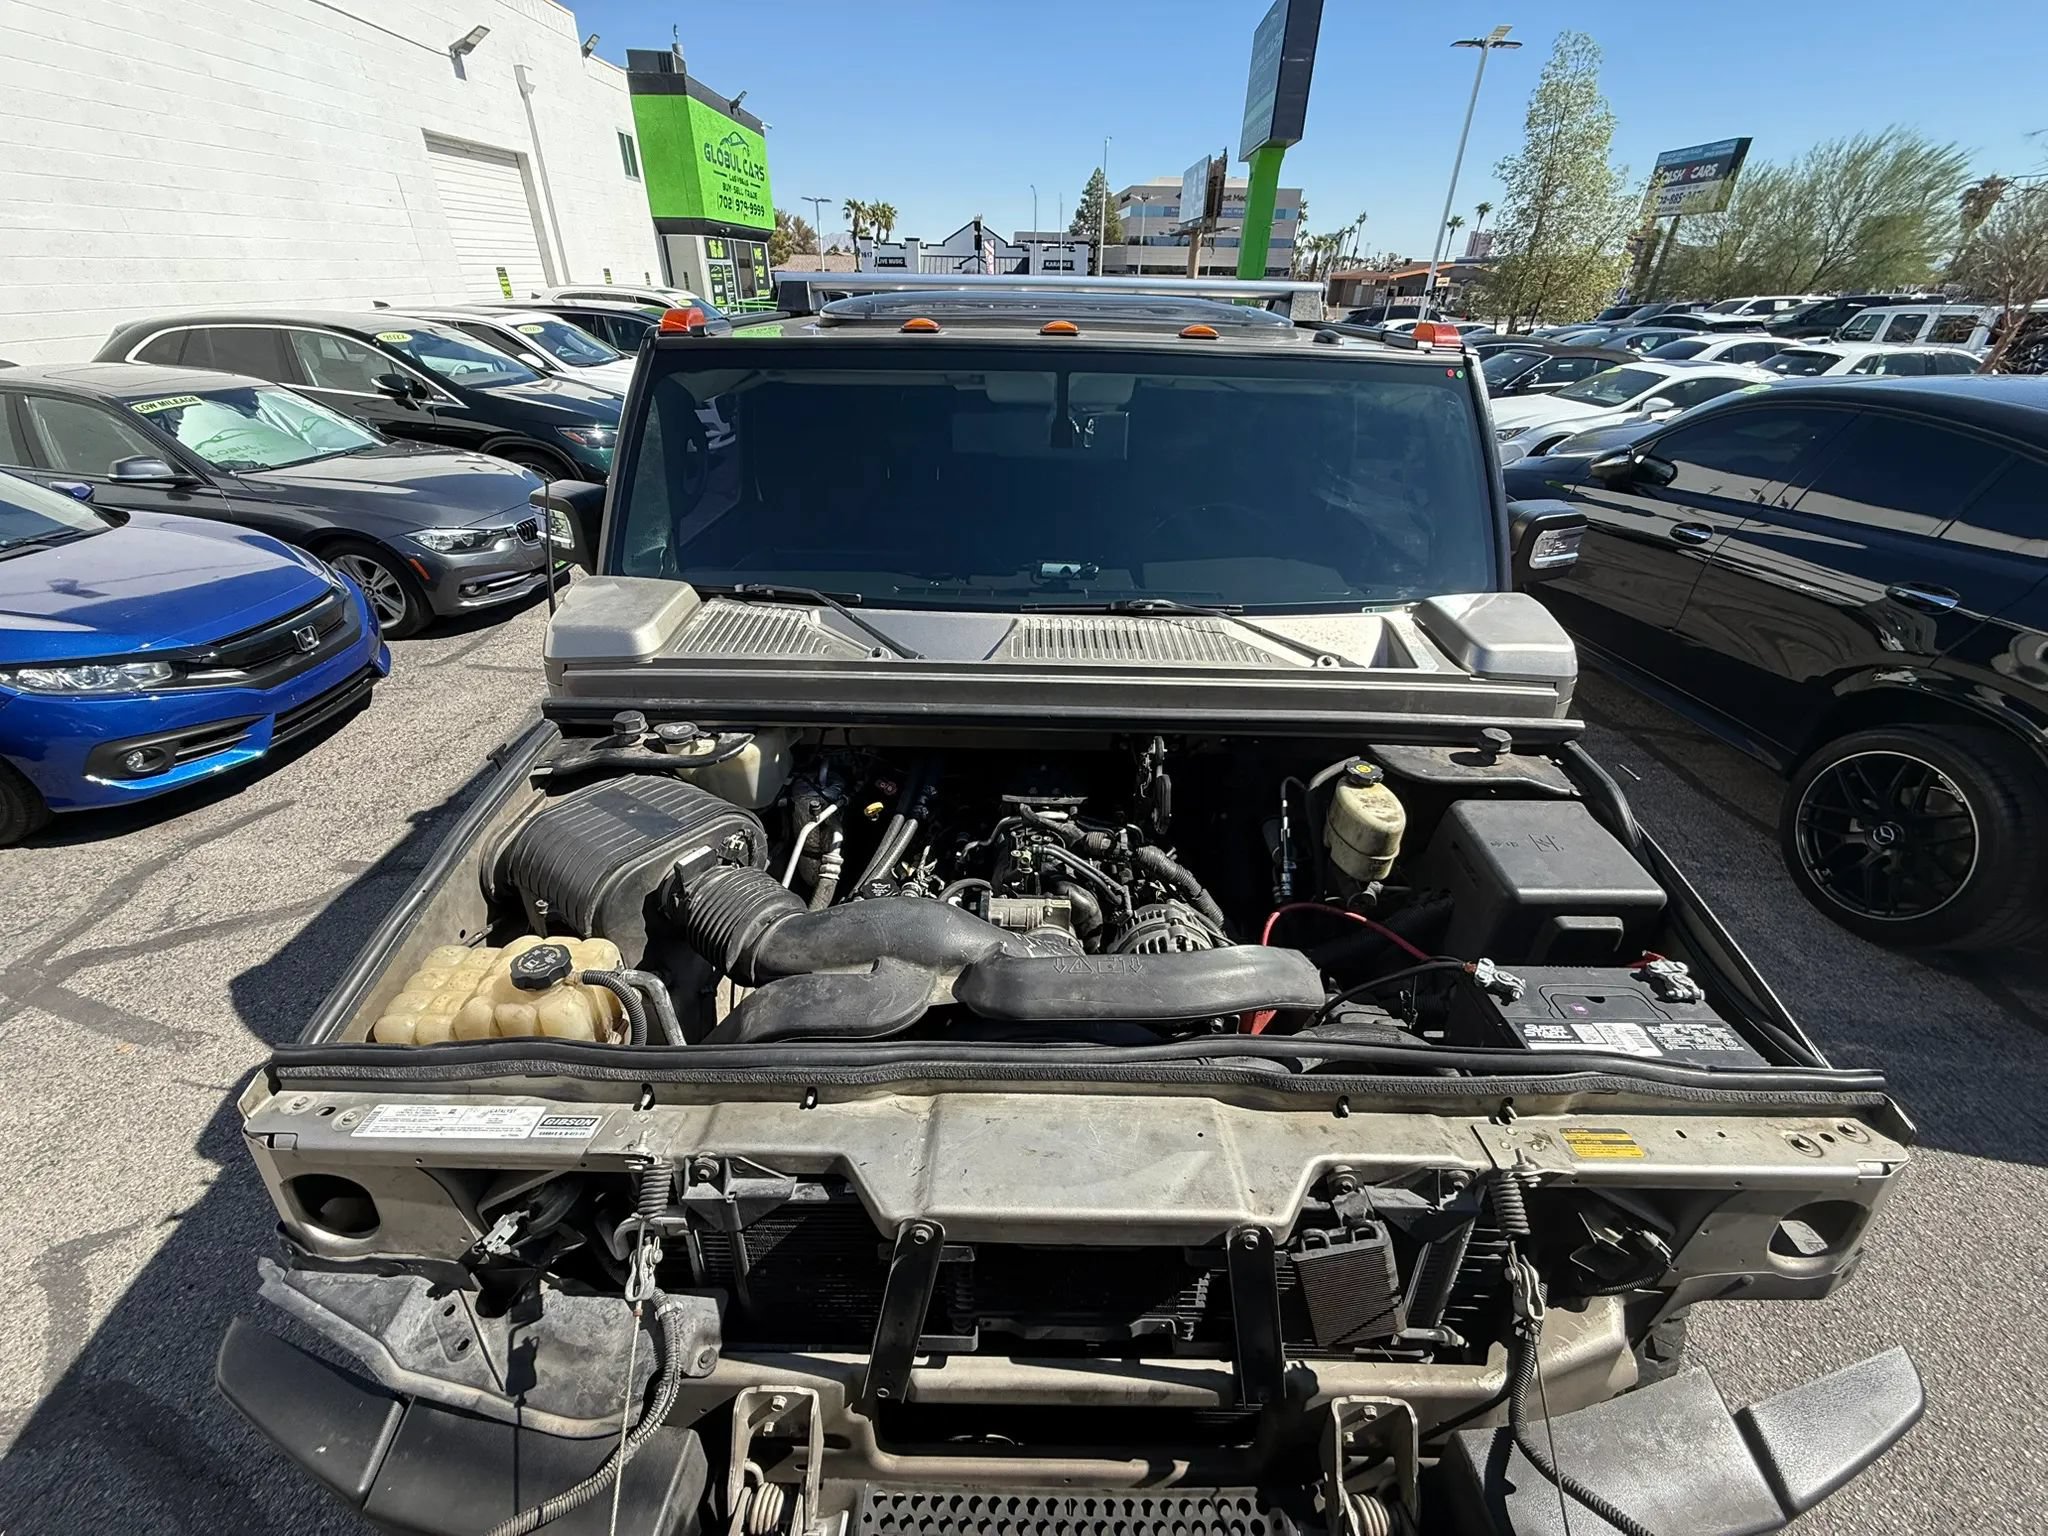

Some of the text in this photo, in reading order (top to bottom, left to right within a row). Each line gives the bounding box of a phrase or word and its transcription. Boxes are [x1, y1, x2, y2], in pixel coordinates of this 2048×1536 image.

[704, 142, 765, 182] GLOBUL CARS
[1690, 163, 1719, 180] CARS
[735, 198, 765, 217] 979-9999
[135, 396, 197, 412] LOW MILEAGE
[543, 1118, 596, 1126] GIBSON
